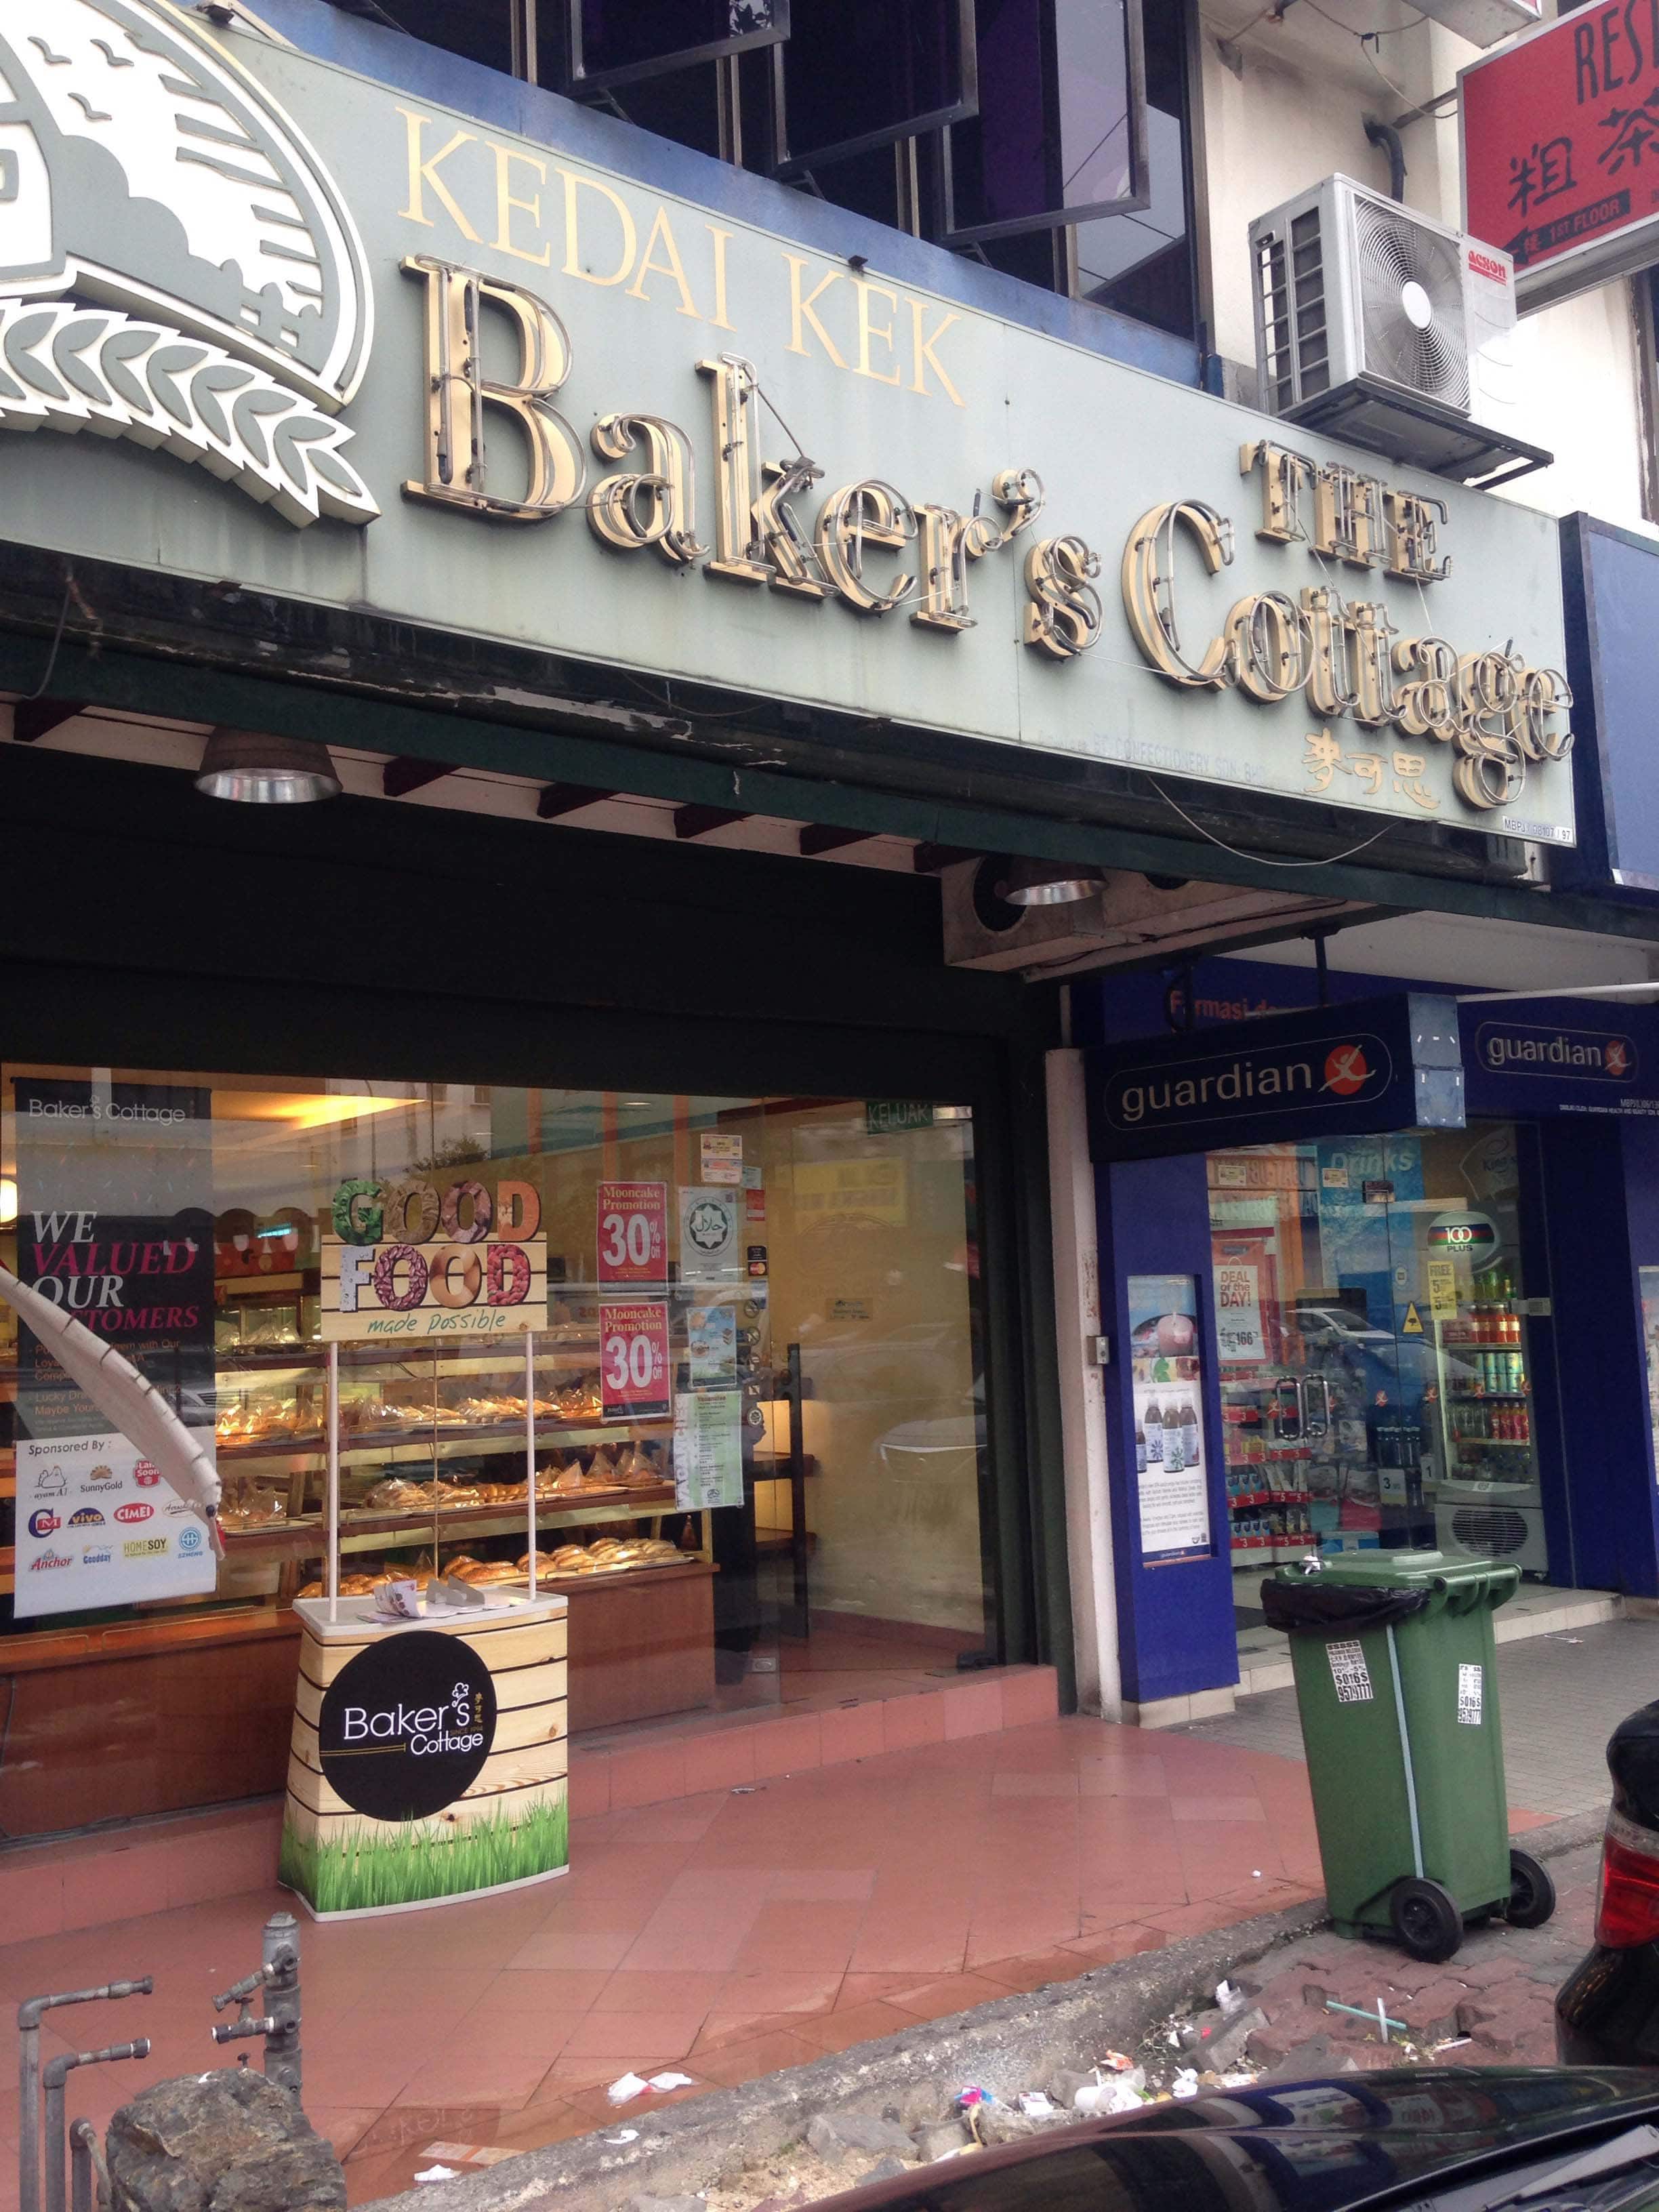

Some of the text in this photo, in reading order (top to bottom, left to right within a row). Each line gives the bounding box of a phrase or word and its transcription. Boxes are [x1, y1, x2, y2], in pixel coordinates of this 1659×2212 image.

[1574, 199, 1620, 232] FLOOR
[396, 106, 967, 407] KEDAI KEK
[1467, 250, 1508, 279] acson
[400, 253, 1104, 663] Baker's
[1240, 438, 1454, 586] THE
[1122, 497, 1575, 811] Cottage
[1504, 818, 1525, 833] MBPJ
[1561, 830, 1571, 840] 97
[1170, 989, 1248, 1020] Frmasi
[1488, 1034, 1603, 1068] guardian
[1122, 1058, 1313, 1122] guardian
[28, 1095, 186, 1126] Baker's Cottage
[602, 1186, 661, 1198] Mooncake
[602, 1198, 661, 1211] Promotion
[332, 1179, 541, 1246] GOOD
[30, 1210, 98, 1244] WE
[1444, 1226, 1473, 1244] 100
[33, 1242, 197, 1277] VALUED
[1429, 1264, 1452, 1277] FREE
[340, 1244, 531, 1312] FOOD
[1221, 1271, 1250, 1283] DEAL
[1221, 1282, 1251, 1292] of the
[1221, 1292, 1252, 1307] DAY!
[367, 1308, 506, 1334] made possible
[605, 1308, 662, 1320] Mooncake
[605, 1319, 663, 1333] Promotion
[28, 1440, 88, 1456] Sponsored
[91, 1439, 105, 1452] By
[80, 1481, 123, 1493] SunnyGold
[72, 1512, 102, 1525] vivo
[31, 1556, 73, 1571] Anchor
[344, 1683, 470, 1740] Baker's
[410, 1730, 484, 1757] Cottage
